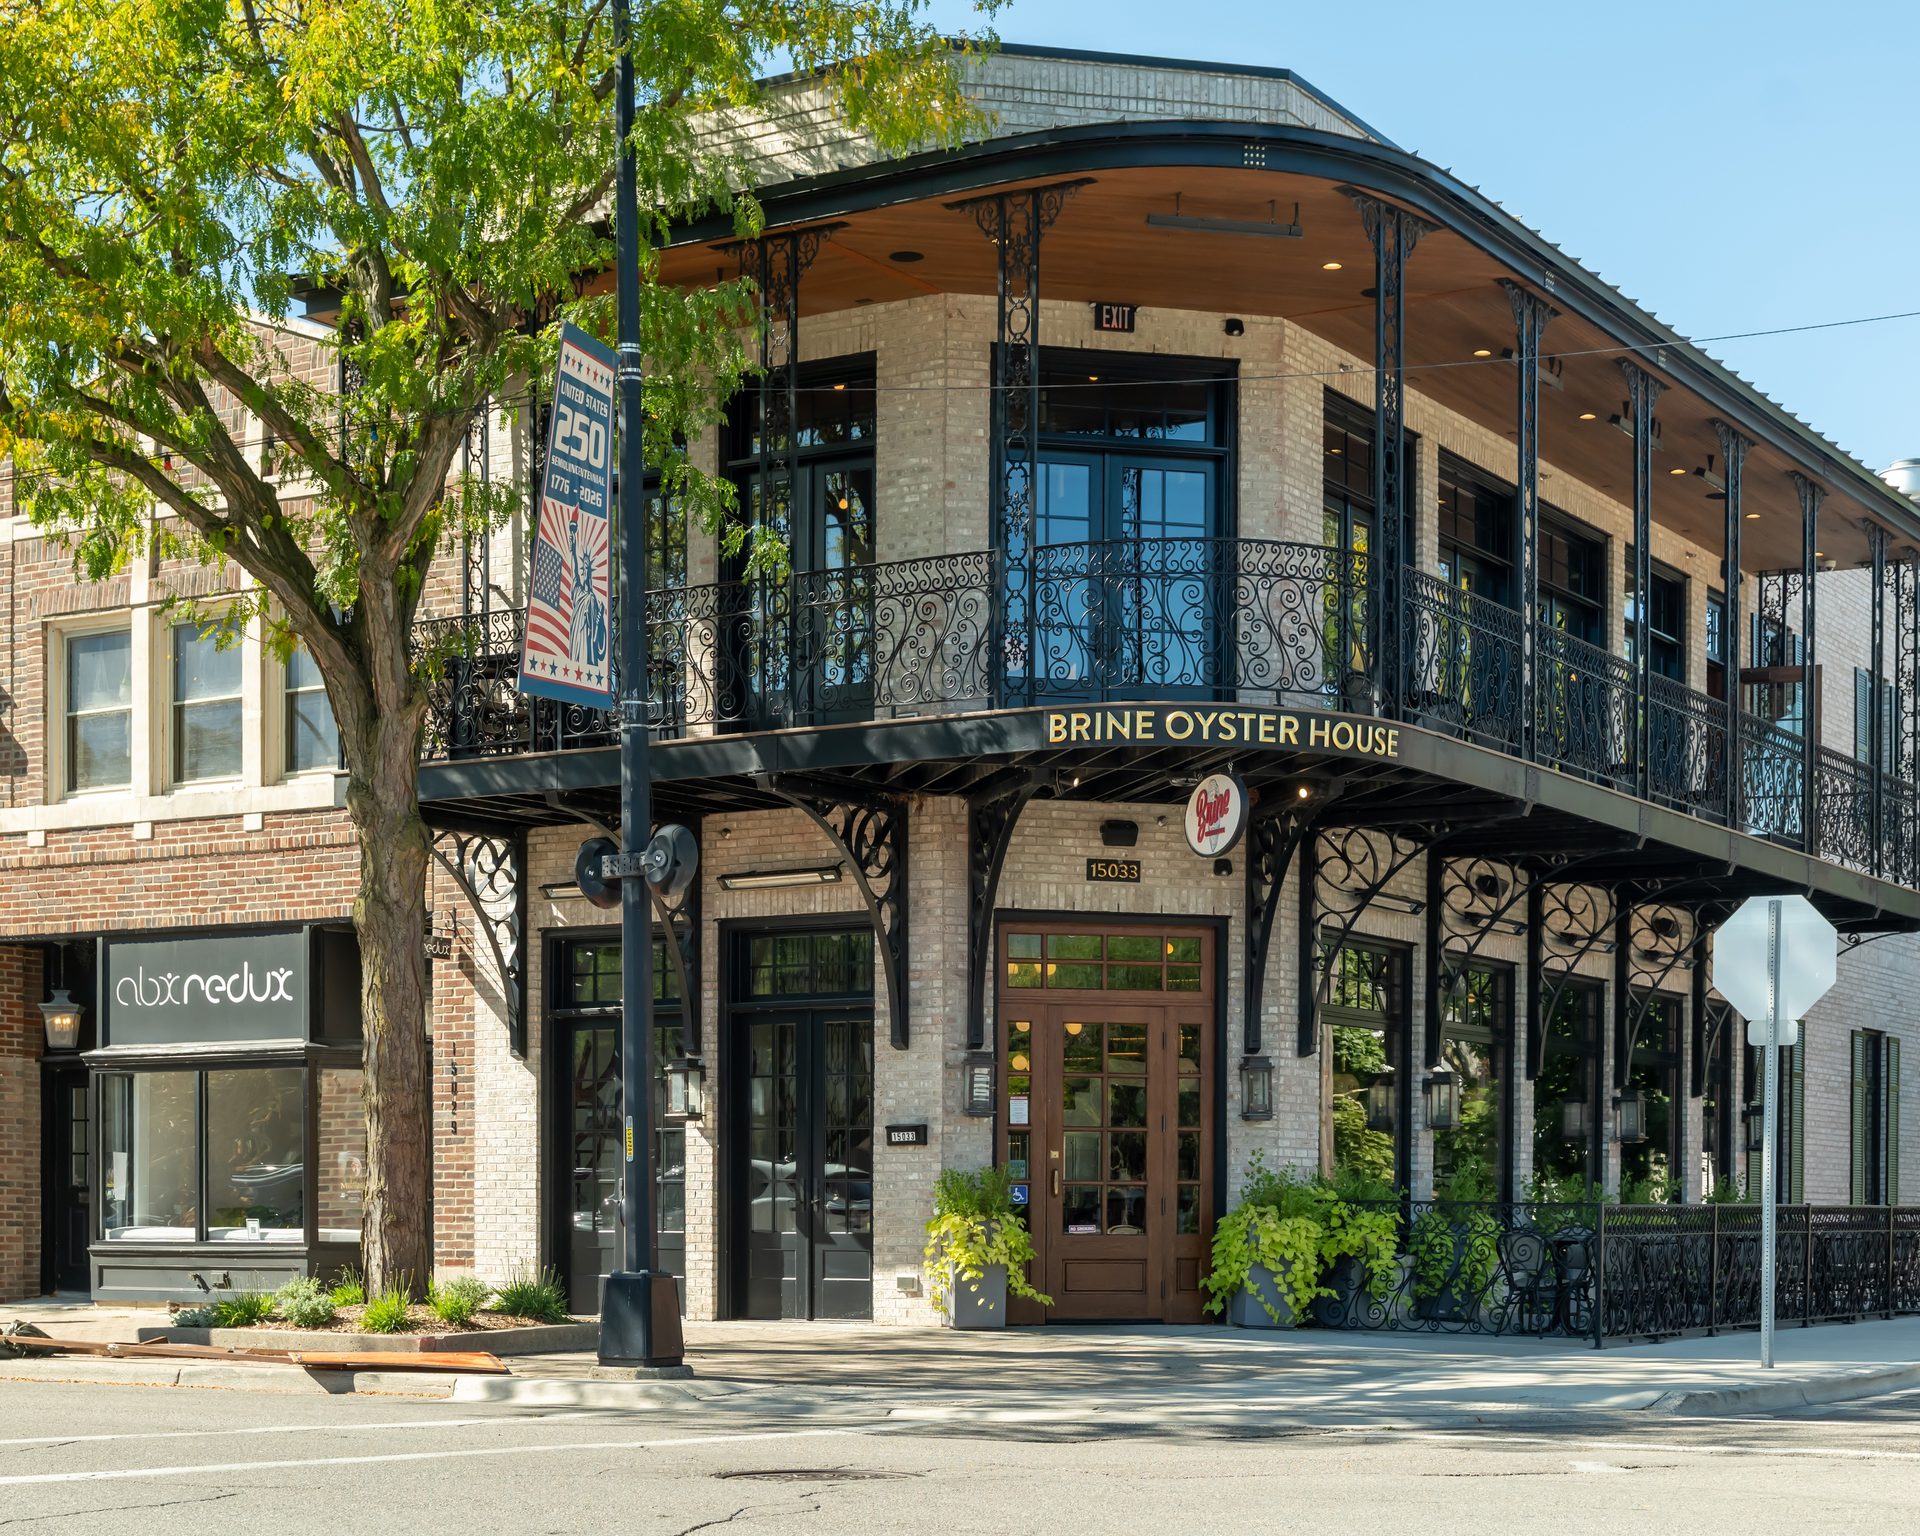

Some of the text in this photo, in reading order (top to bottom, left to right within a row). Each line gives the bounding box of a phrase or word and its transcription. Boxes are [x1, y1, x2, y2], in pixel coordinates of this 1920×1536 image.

[1103, 305, 1130, 329] EXIT
[561, 380, 608, 418] UNITED STATES
[554, 403, 606, 469] 250
[551, 473, 570, 495] 1776
[579, 485, 602, 508] 2026
[1049, 710, 1400, 758] BRINE OYSTER HOUSE
[1196, 789, 1231, 843] Brine
[1091, 863, 1138, 879] 15033
[892, 1132, 915, 1141] 15033
